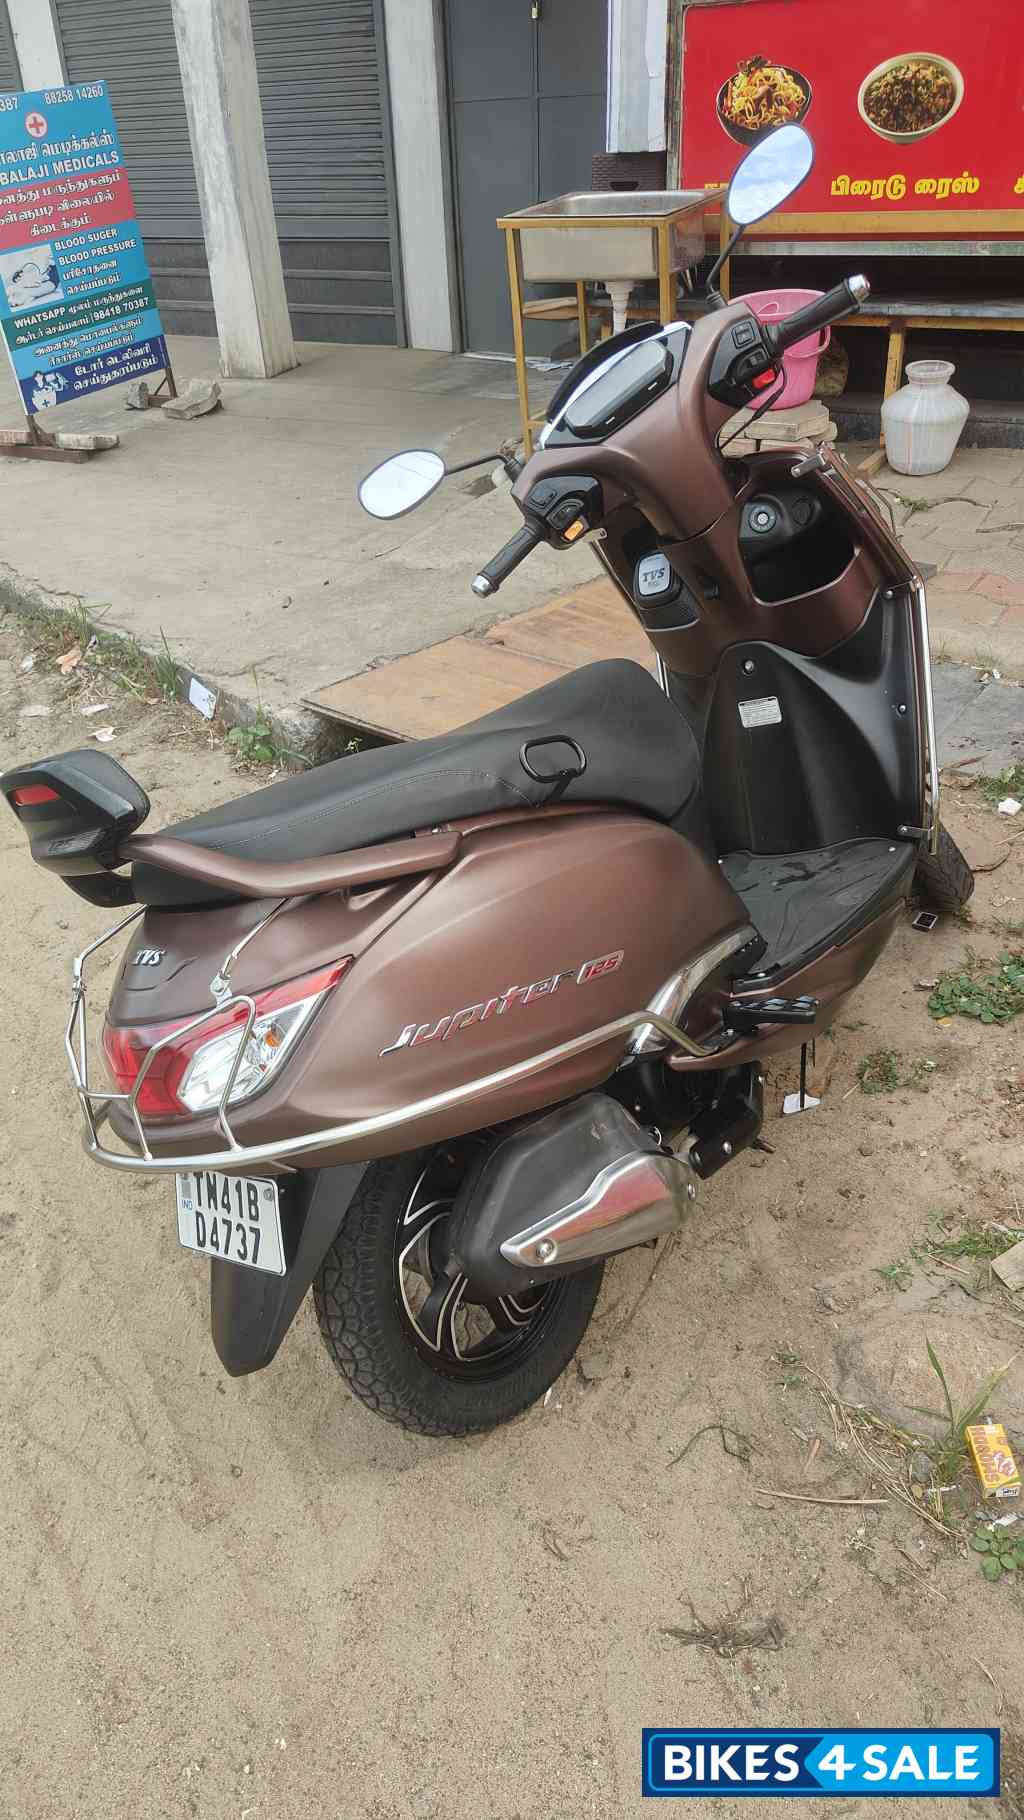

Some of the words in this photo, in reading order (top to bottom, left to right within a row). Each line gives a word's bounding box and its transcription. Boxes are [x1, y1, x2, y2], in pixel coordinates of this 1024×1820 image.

[0, 164, 49, 185] BALAJI
[53, 150, 119, 175] MEDICALS
[831, 174, 906, 200] பிரைடு
[914, 171, 980, 199] ரைஸ்
[54, 236, 85, 251] BLOOD
[88, 228, 118, 242] SUGER
[58, 250, 89, 266] BLOOD
[91, 239, 137, 257] PRESSURE
[14, 306, 65, 329] WHATSAPP
[123, 296, 149, 312] 70387
[133, 949, 165, 967] TVS
[582, 954, 621, 981] 125
[192, 1170, 260, 1222] TN41B
[195, 1210, 261, 1265] D4737
